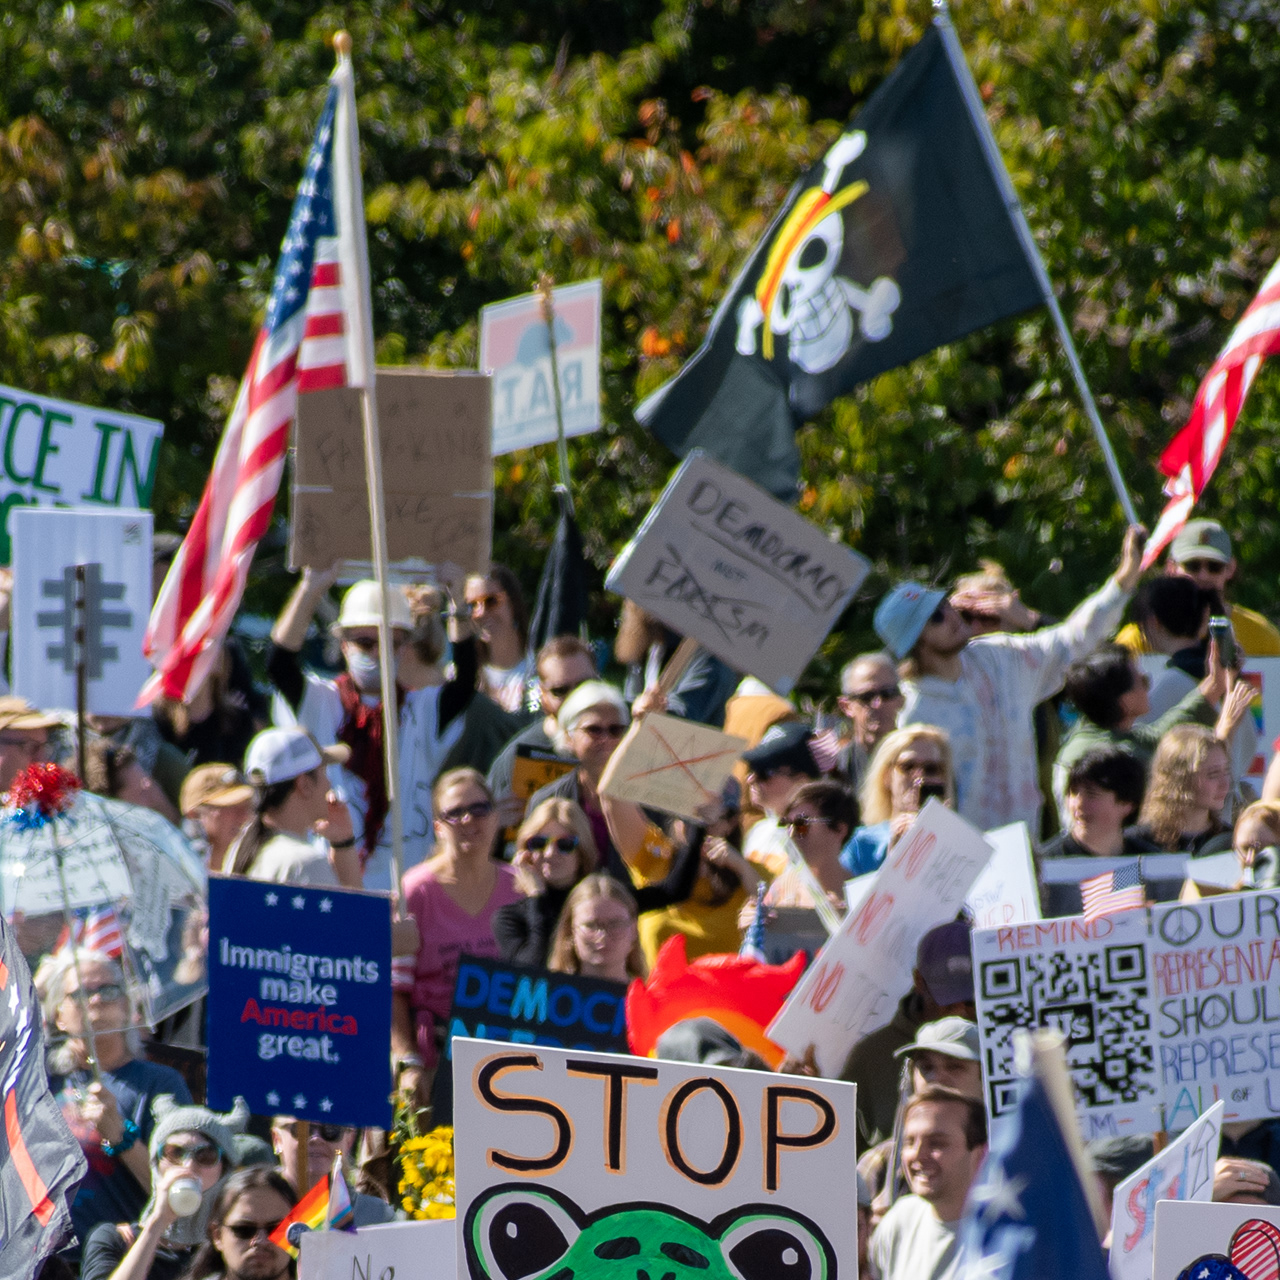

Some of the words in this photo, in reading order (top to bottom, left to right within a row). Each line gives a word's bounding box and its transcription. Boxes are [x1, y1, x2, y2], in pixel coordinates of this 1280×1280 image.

[83, 422, 162, 509] IN
[220, 938, 380, 985] Immigrants
[260, 977, 338, 1007] make
[241, 997, 358, 1036] America
[258, 1033, 340, 1064] great.
[472, 1050, 839, 1192] STOP
